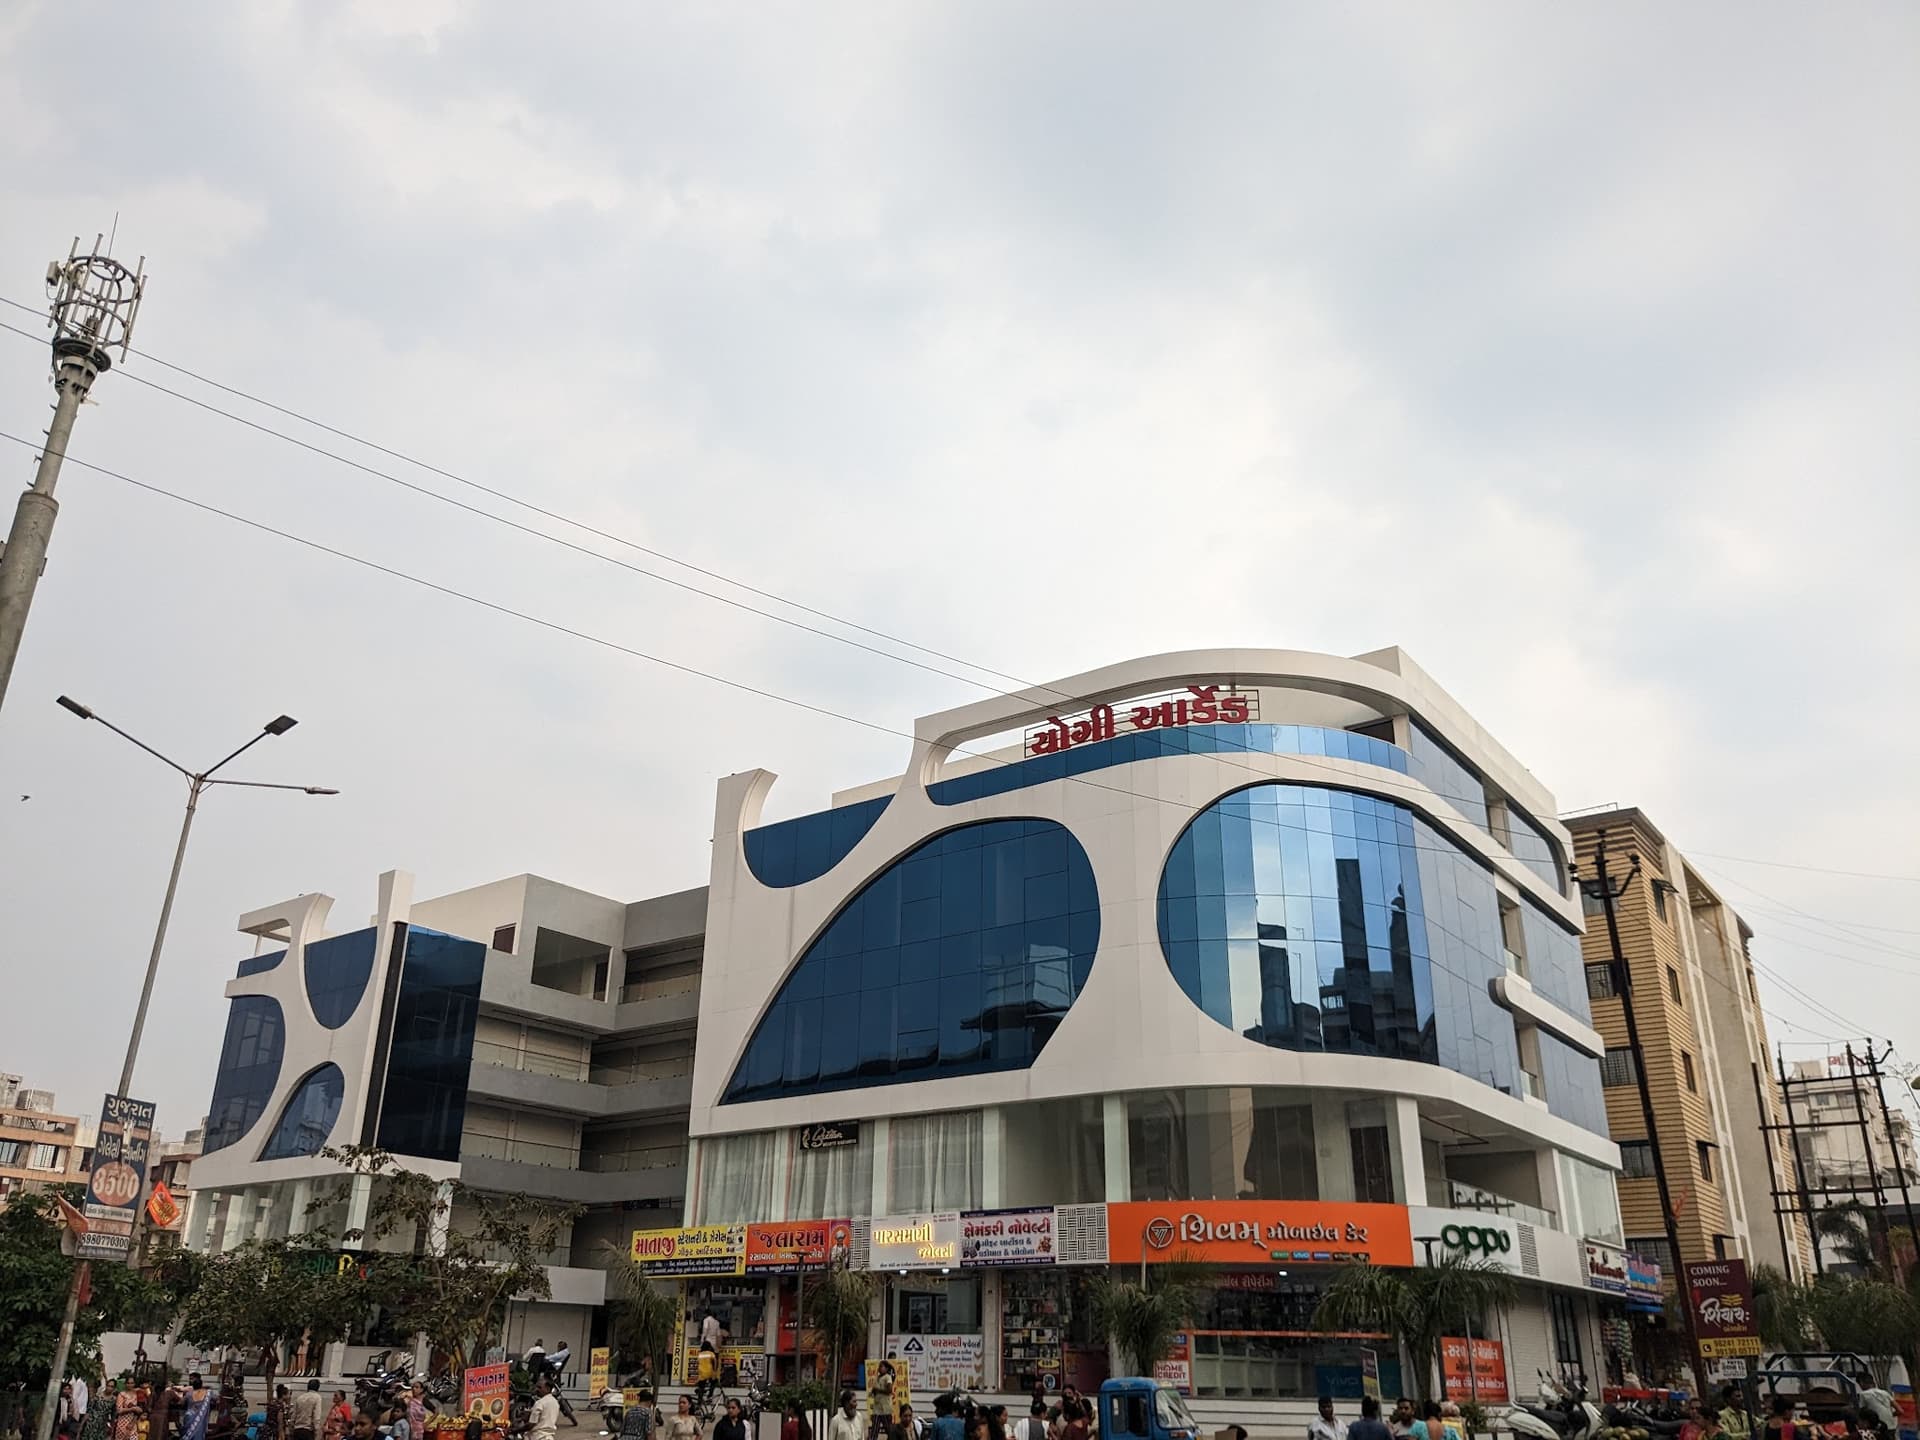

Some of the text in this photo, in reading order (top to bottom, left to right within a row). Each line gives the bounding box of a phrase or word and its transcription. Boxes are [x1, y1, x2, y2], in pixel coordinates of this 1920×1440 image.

[1031, 686, 1249, 755] યોગી આર્કેડ
[107, 1097, 153, 1119] ગુજરાત
[1008, 1216, 1050, 1235] નોવેલ્ટી
[1180, 1213, 1267, 1249] શિવમ્
[1345, 1222, 1368, 1243] કેર
[635, 1236, 675, 1258] માતાજી
[760, 1229, 825, 1248] જલારામ
[1441, 1224, 1511, 1258] oppo
[1690, 1265, 1730, 1276] COMING
[1156, 1364, 1184, 1372] HOME
[1157, 1371, 1186, 1379] CREDIT
